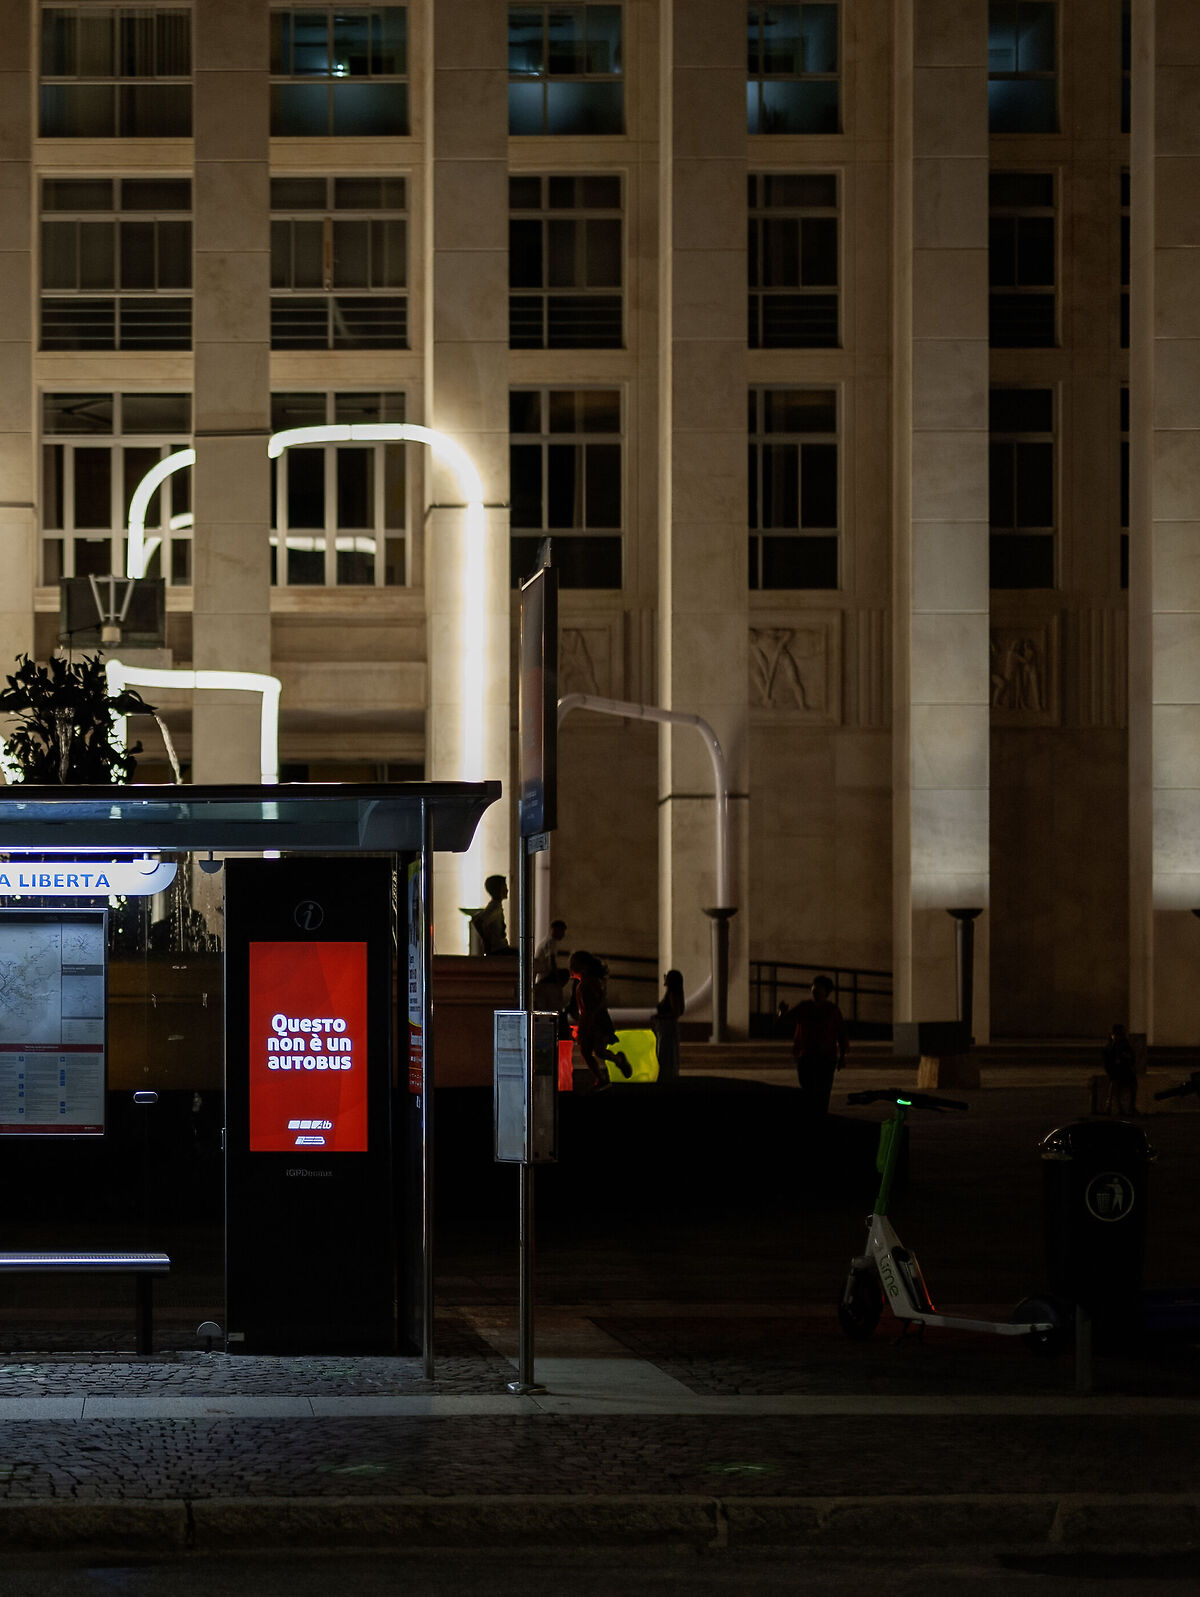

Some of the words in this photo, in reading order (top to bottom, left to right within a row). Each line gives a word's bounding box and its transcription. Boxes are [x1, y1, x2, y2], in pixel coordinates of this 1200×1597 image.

[267, 1037, 305, 1051] non
[310, 1033, 322, 1051] è
[327, 1037, 352, 1051] un
